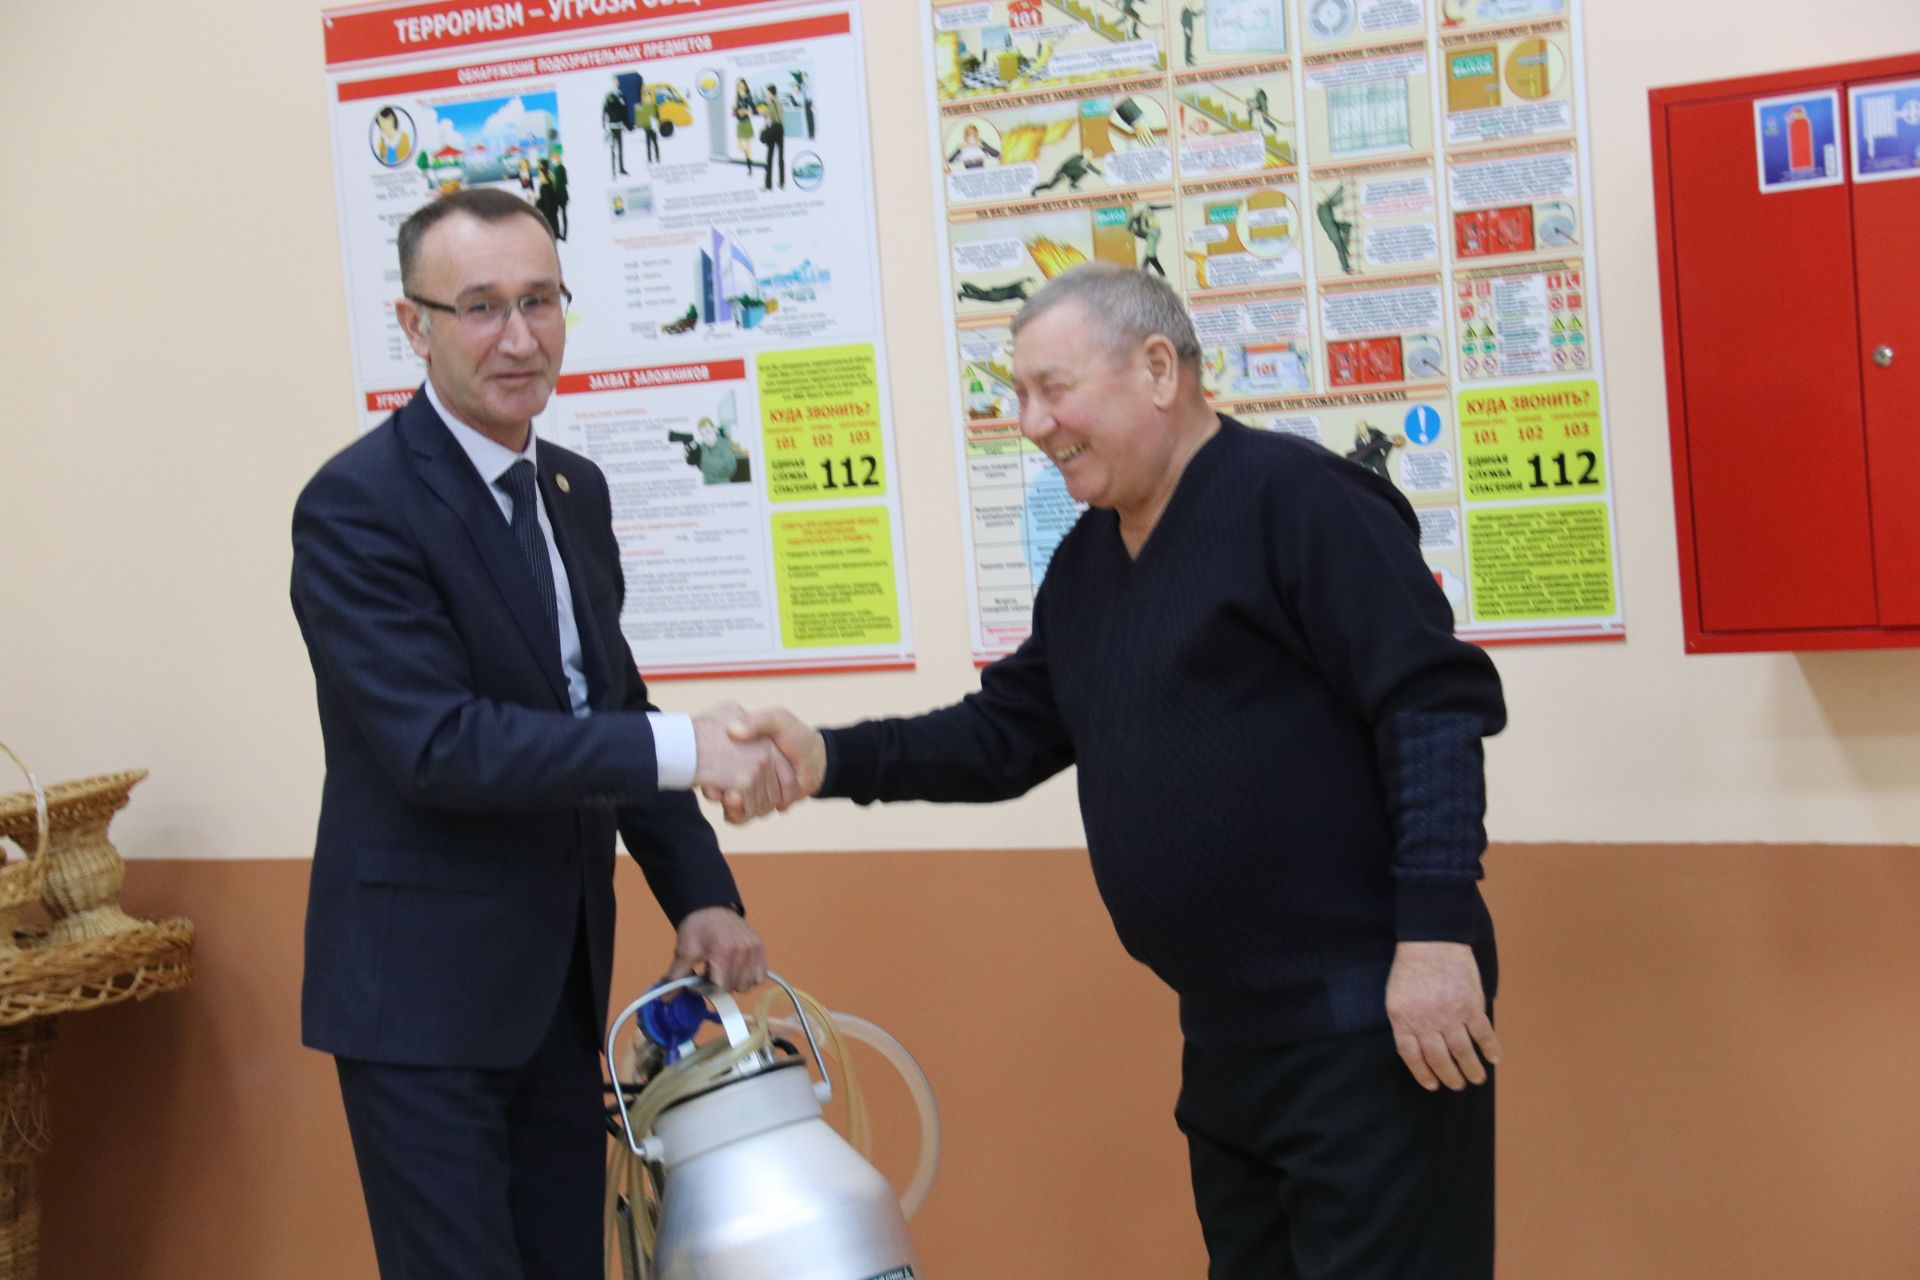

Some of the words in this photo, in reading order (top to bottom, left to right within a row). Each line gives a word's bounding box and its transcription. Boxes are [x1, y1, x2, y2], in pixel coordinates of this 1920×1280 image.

[393, 2, 525, 43] ТЕРРОРИЗМ
[457, 58, 538, 84] ОБНАРУЖЕНИЕ
[538, 44, 643, 74] ПОДОЗРИТЕЛЬНЫХ
[643, 34, 713, 59] ПРЕДМЕТОВ
[589, 366, 631, 390] ЗАХВАТ
[633, 364, 710, 385] ЗАЛОЖНИКОВ
[769, 408, 804, 424] КУДА
[806, 400, 871, 419] ЗВОНИТЬ?
[1466, 397, 1507, 415] КУДА
[1511, 390, 1591, 411] ЗВОНИТЬ?
[775, 436, 797, 450] 101
[812, 432, 833, 448] 102
[849, 430, 872, 446] 103
[1474, 430, 1497, 445] 101
[1519, 426, 1544, 441] 102
[1563, 421, 1589, 438] 103
[820, 454, 880, 489] 112
[1468, 467, 1511, 481] СЛУЖБА
[1527, 450, 1600, 488] 112
